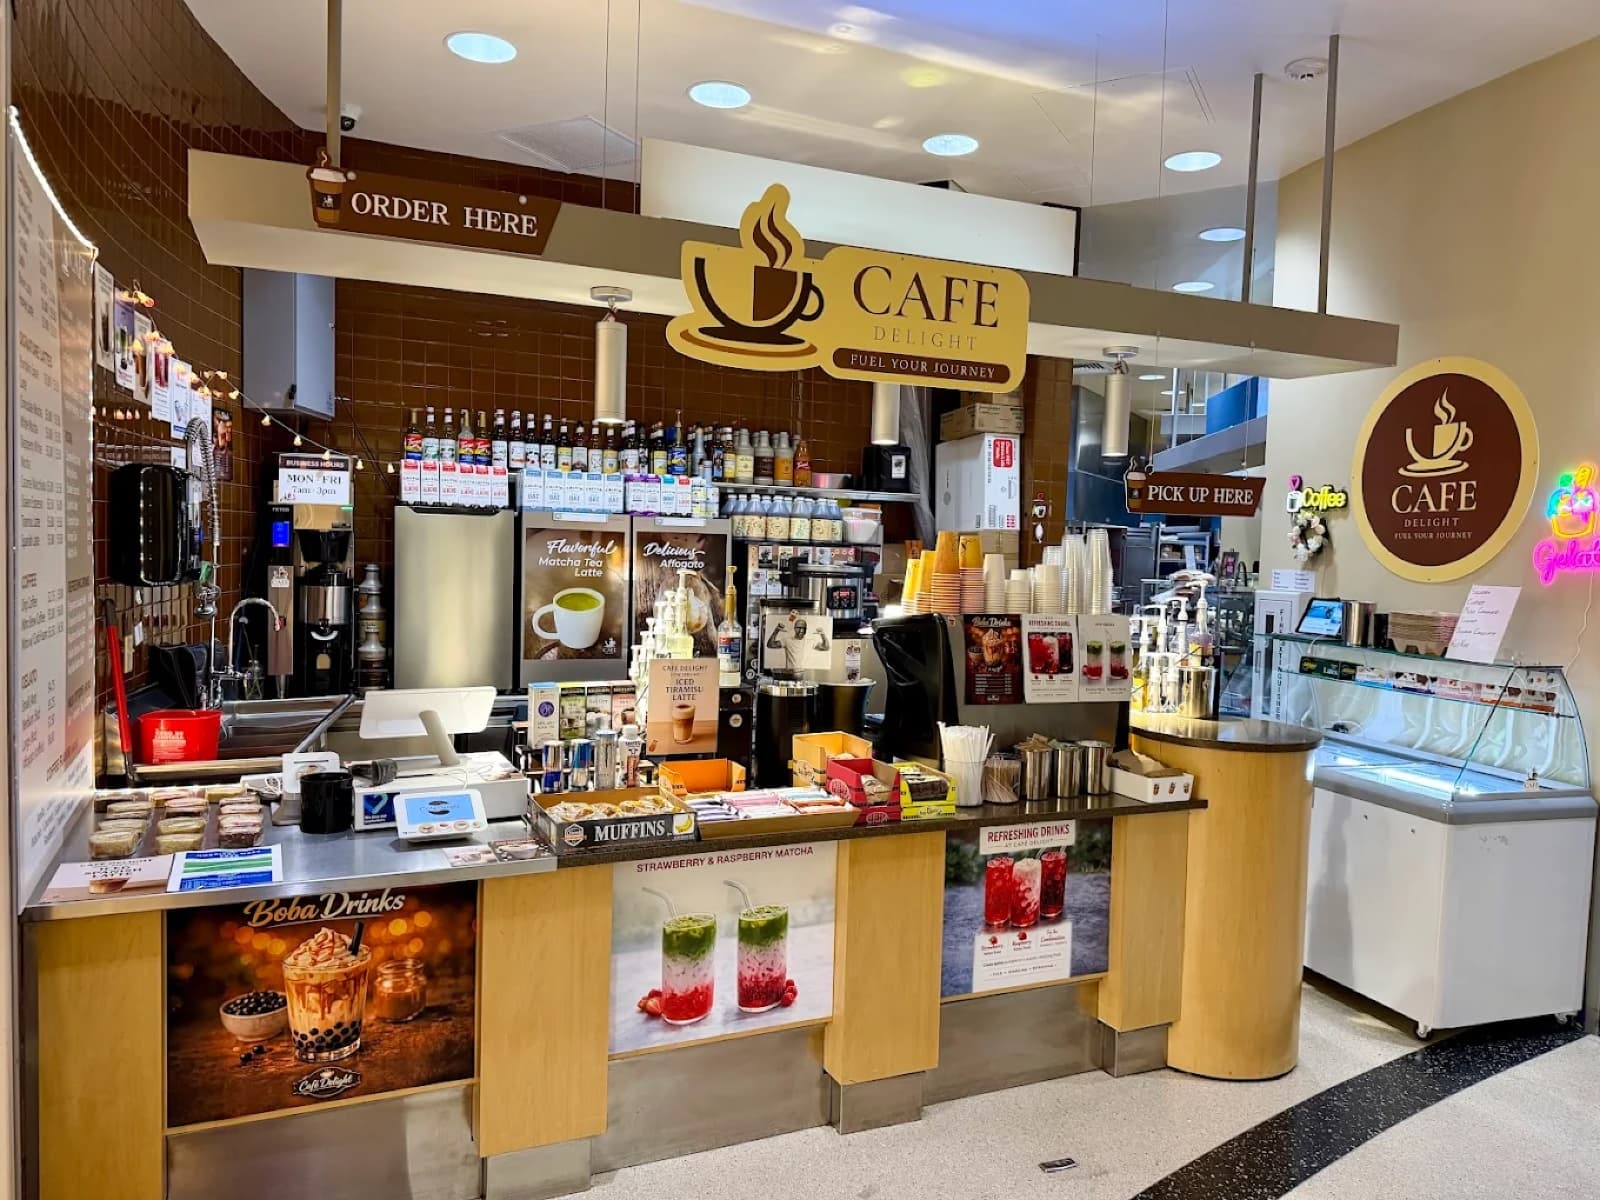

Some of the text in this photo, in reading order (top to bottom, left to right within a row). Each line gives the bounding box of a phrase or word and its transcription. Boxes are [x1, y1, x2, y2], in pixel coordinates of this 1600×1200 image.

[351, 192, 538, 237] ORDER HERE
[853, 265, 999, 328] CAFE
[874, 325, 977, 351] DELIGHT
[850, 353, 996, 379] FUEL YOUR JOURNEY
[287, 474, 341, 484] MON FRI
[1148, 485, 1254, 505] PICK UP HERE
[1302, 485, 1347, 510] Coffee
[1391, 480, 1477, 514] CAFE
[1404, 517, 1461, 527] DELIGHT
[1436, 531, 1473, 539] JOURNEY
[547, 539, 618, 555] Flavorful
[643, 542, 706, 557] Delicious
[538, 556, 603, 567] Matcha Tea
[660, 559, 705, 569] Affogato
[1534, 539, 1600, 585] Gelat
[574, 568, 604, 577] Latte
[594, 820, 665, 841] MUFFINS
[988, 824, 1070, 842] REFRESHING DRINKS
[637, 846, 813, 872] STRAWBERRY & RASPBERRY MATCHA
[243, 888, 405, 927] Boba Drinks
[298, 1072, 352, 1093] Café Delight
